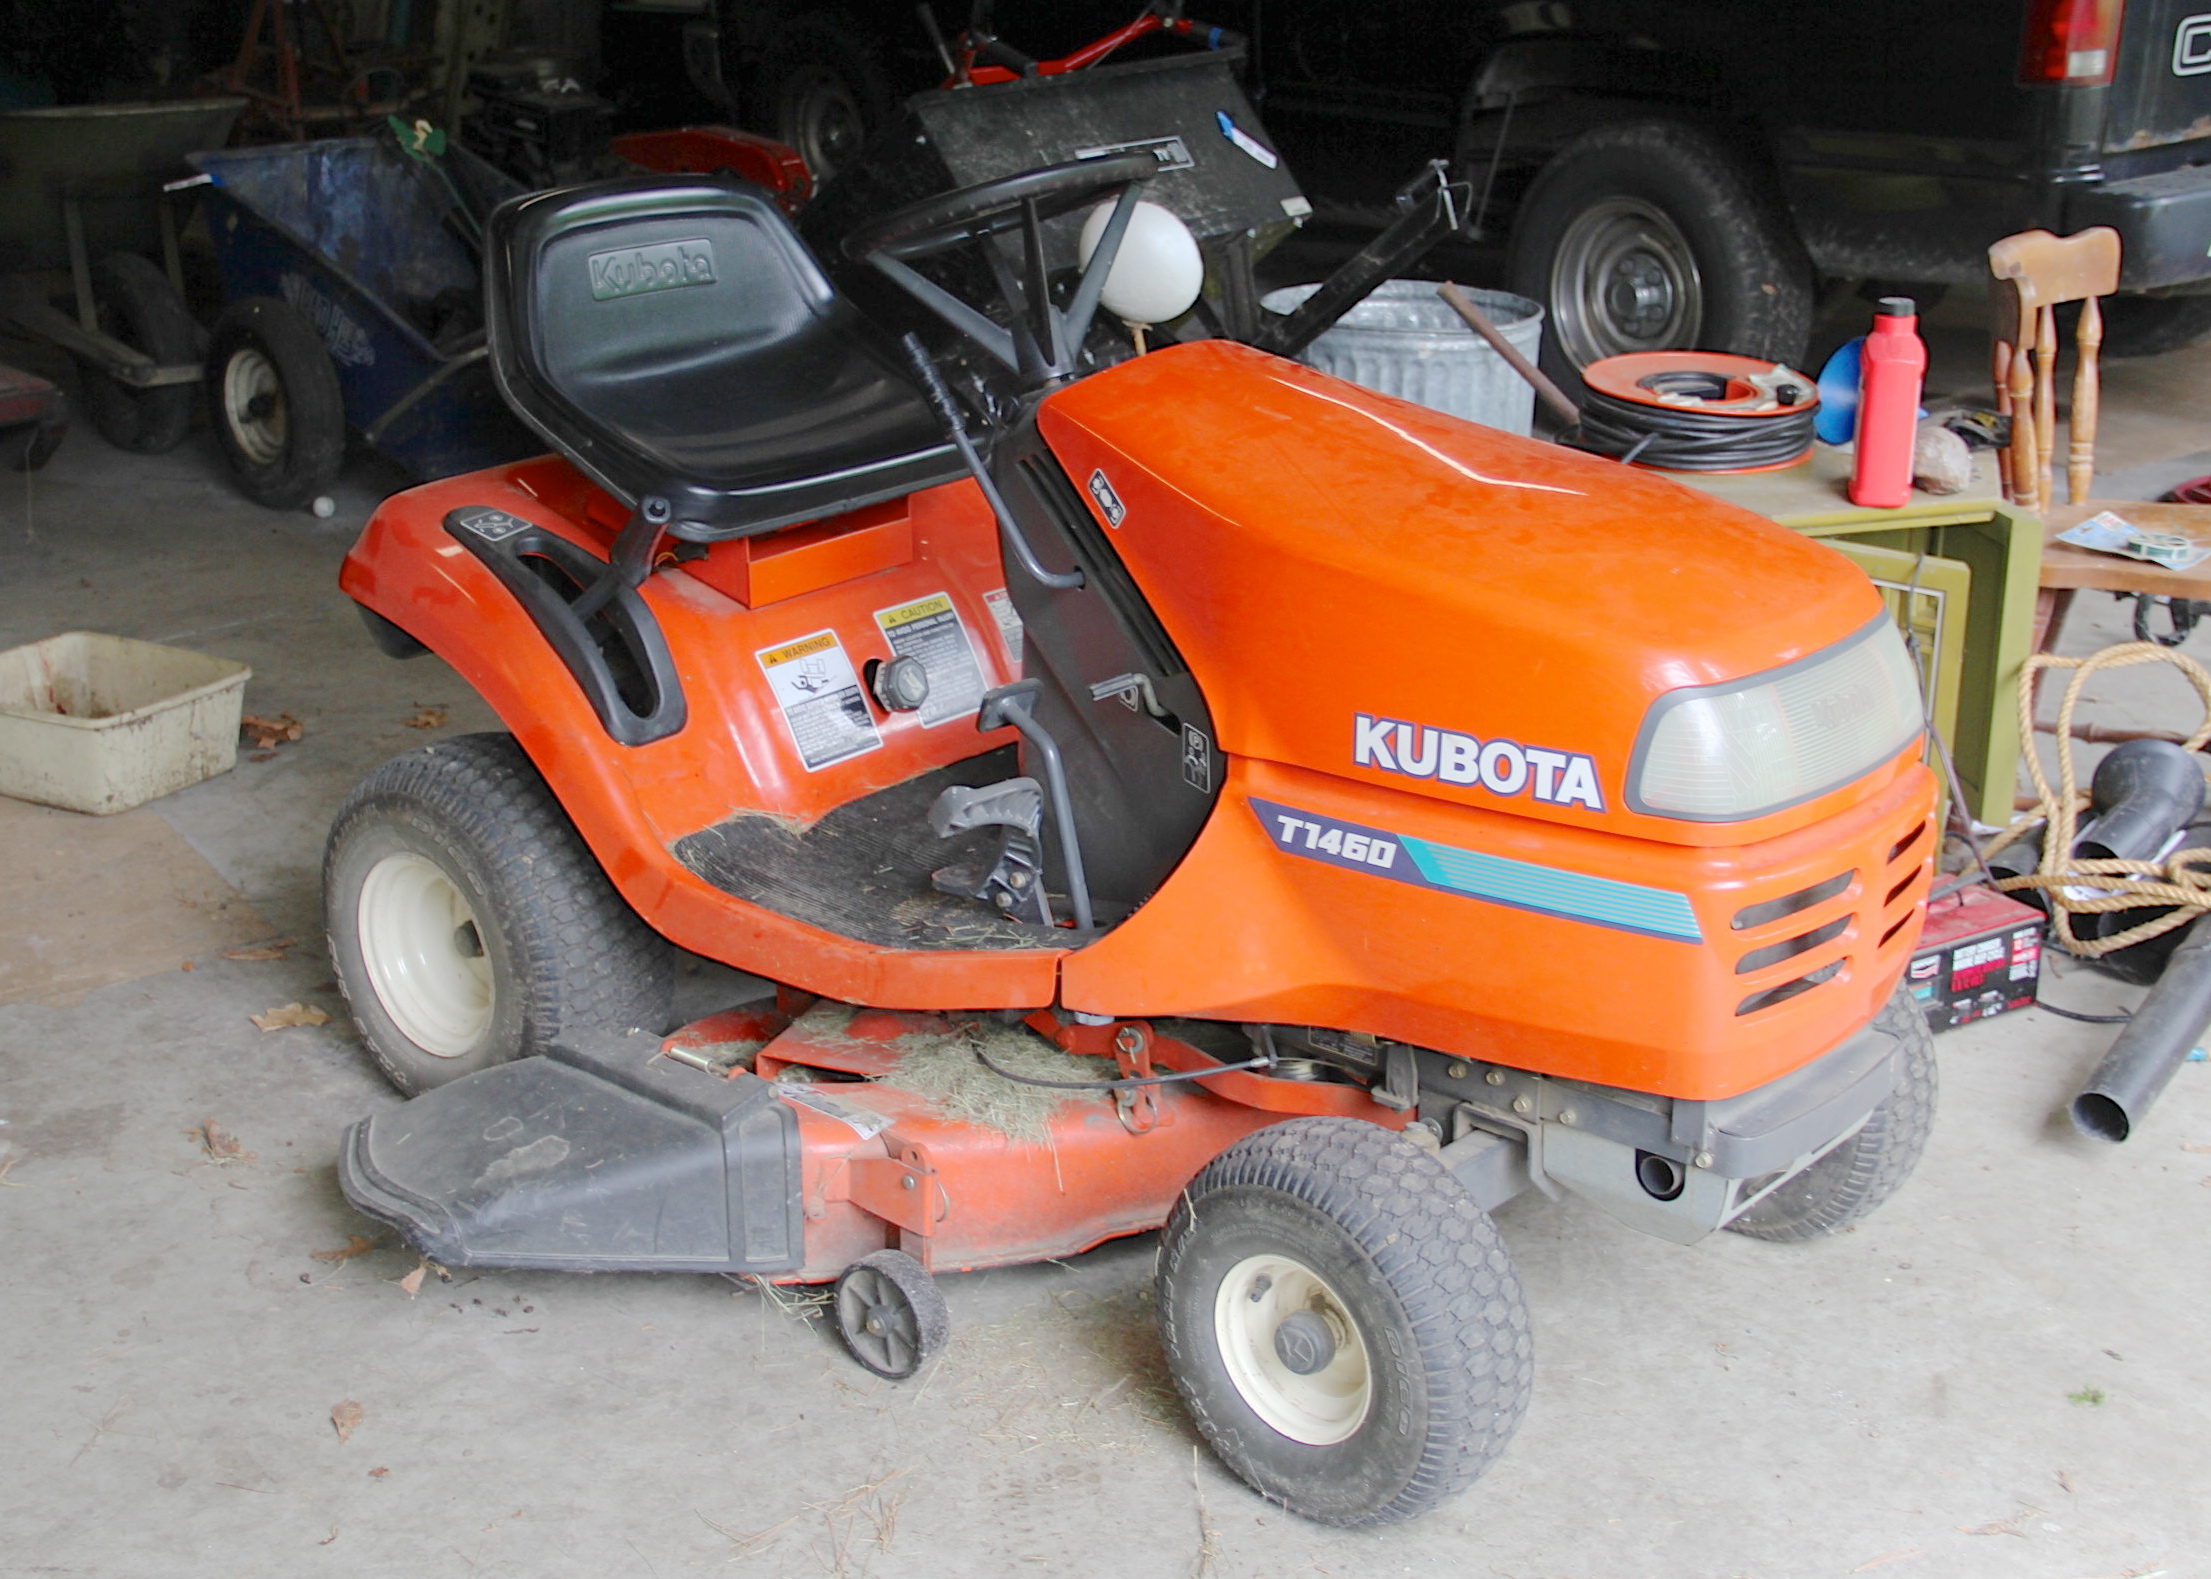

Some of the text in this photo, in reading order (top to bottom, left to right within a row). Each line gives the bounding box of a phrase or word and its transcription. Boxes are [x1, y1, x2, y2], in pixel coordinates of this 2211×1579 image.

[591, 245, 712, 293] Kubota
[900, 600, 943, 620] CAUTION
[781, 637, 831, 659] WARNING
[1354, 713, 1606, 813] KUBOTA
[1277, 814, 1398, 869] T1460
